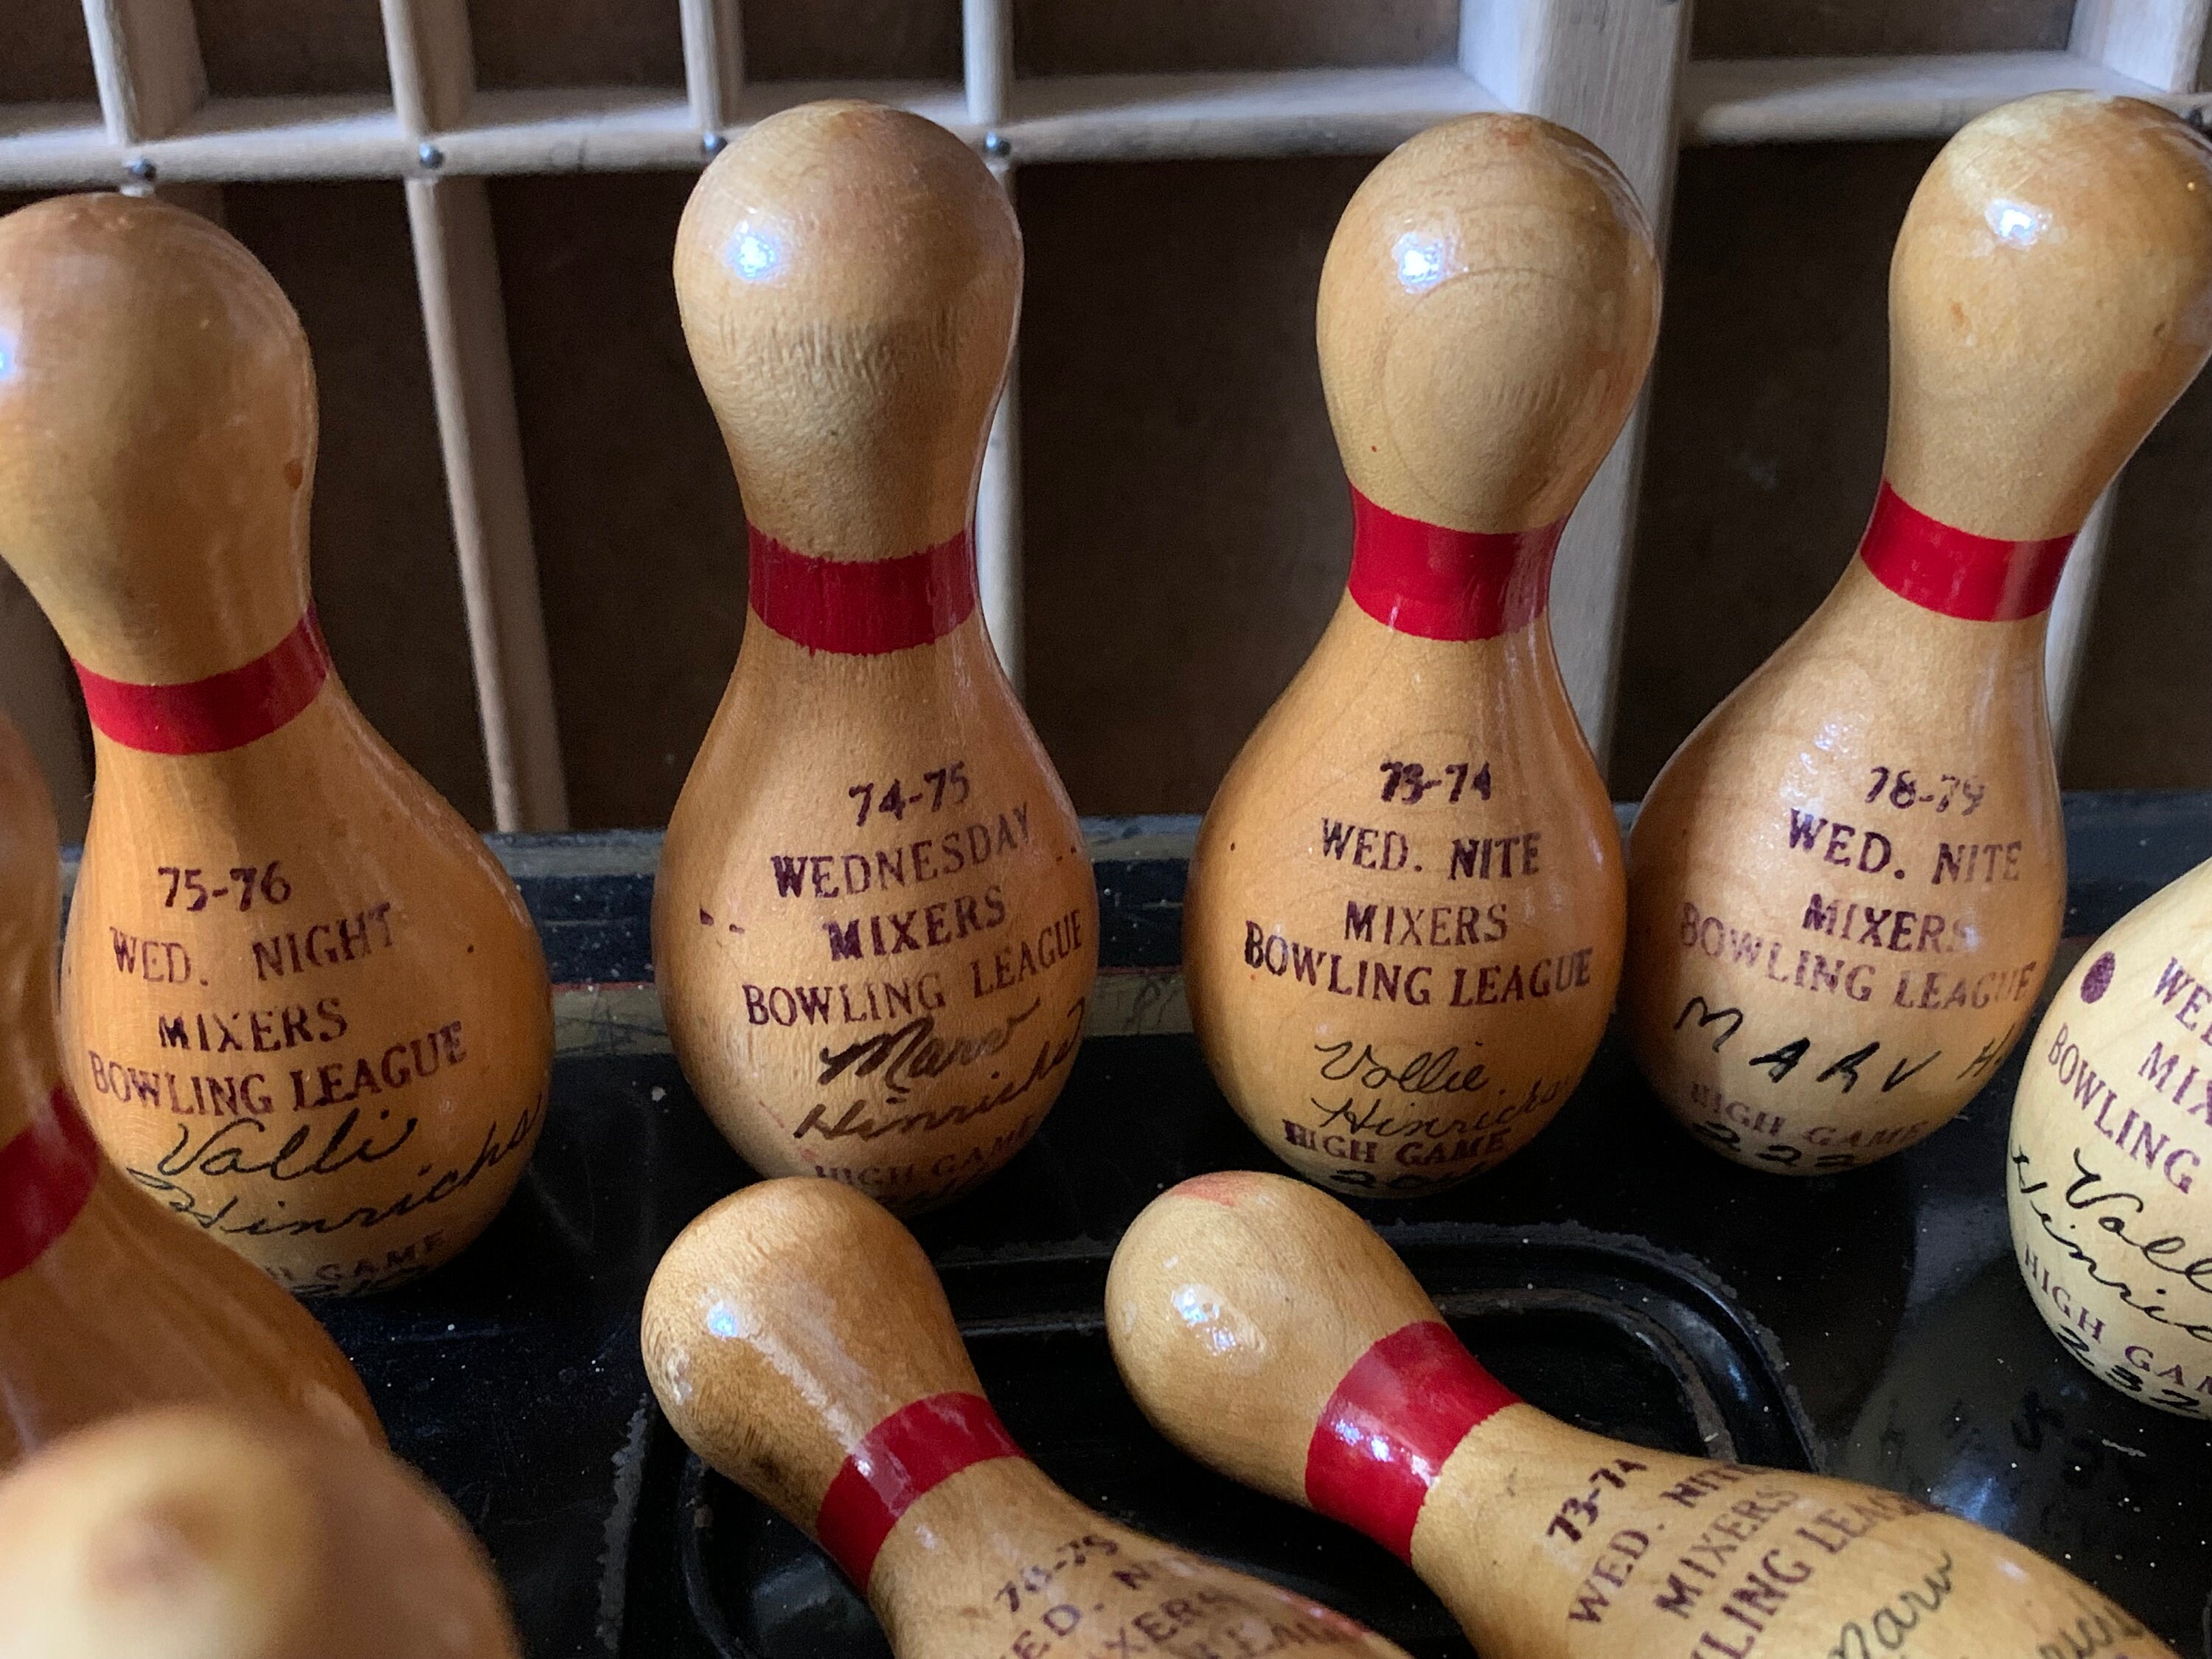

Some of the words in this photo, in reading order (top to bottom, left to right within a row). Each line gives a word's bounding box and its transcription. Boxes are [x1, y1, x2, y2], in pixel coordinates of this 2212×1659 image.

[849, 760, 972, 827] 74-75
[1380, 761, 1492, 804] 73-74
[158, 861, 292, 911] 75-76
[771, 801, 1032, 898] WEDNESDAY
[1321, 817, 1423, 872] WED.
[1447, 831, 1542, 881] NITE
[1789, 807, 1906, 880] WED.
[1932, 841, 2023, 885] NITE
[109, 927, 209, 987] WED.
[252, 902, 396, 981] NIGHT
[742, 971, 946, 1026] BOWLING
[970, 908, 1084, 999] LEAGUE
[822, 885, 1007, 961] MIXERS
[1245, 919, 1433, 1006] BOWLING
[1449, 947, 1594, 1008] LEAGUE
[1344, 900, 1509, 947] MIXERS
[1681, 901, 1876, 1003] BOWLING
[158, 997, 348, 1053] MIXERS
[1674, 996, 1942, 1093] MARV
[2154, 956, 2212, 1047] WE
[88, 1050, 274, 1117] BOWLING
[289, 1020, 467, 1112] LEAGUE
[2048, 1023, 2201, 1194] BOWLING
[1282, 1119, 1379, 1164] HIGH
[1395, 1127, 1512, 1167] GAME
[2025, 1243, 2105, 1344] HIGH
[1547, 1459, 1648, 1543] 73-74
[1568, 1529, 1665, 1623] WED.
[1653, 1488, 1800, 1620] MIXERS
[1691, 1548, 1814, 1659] LING
